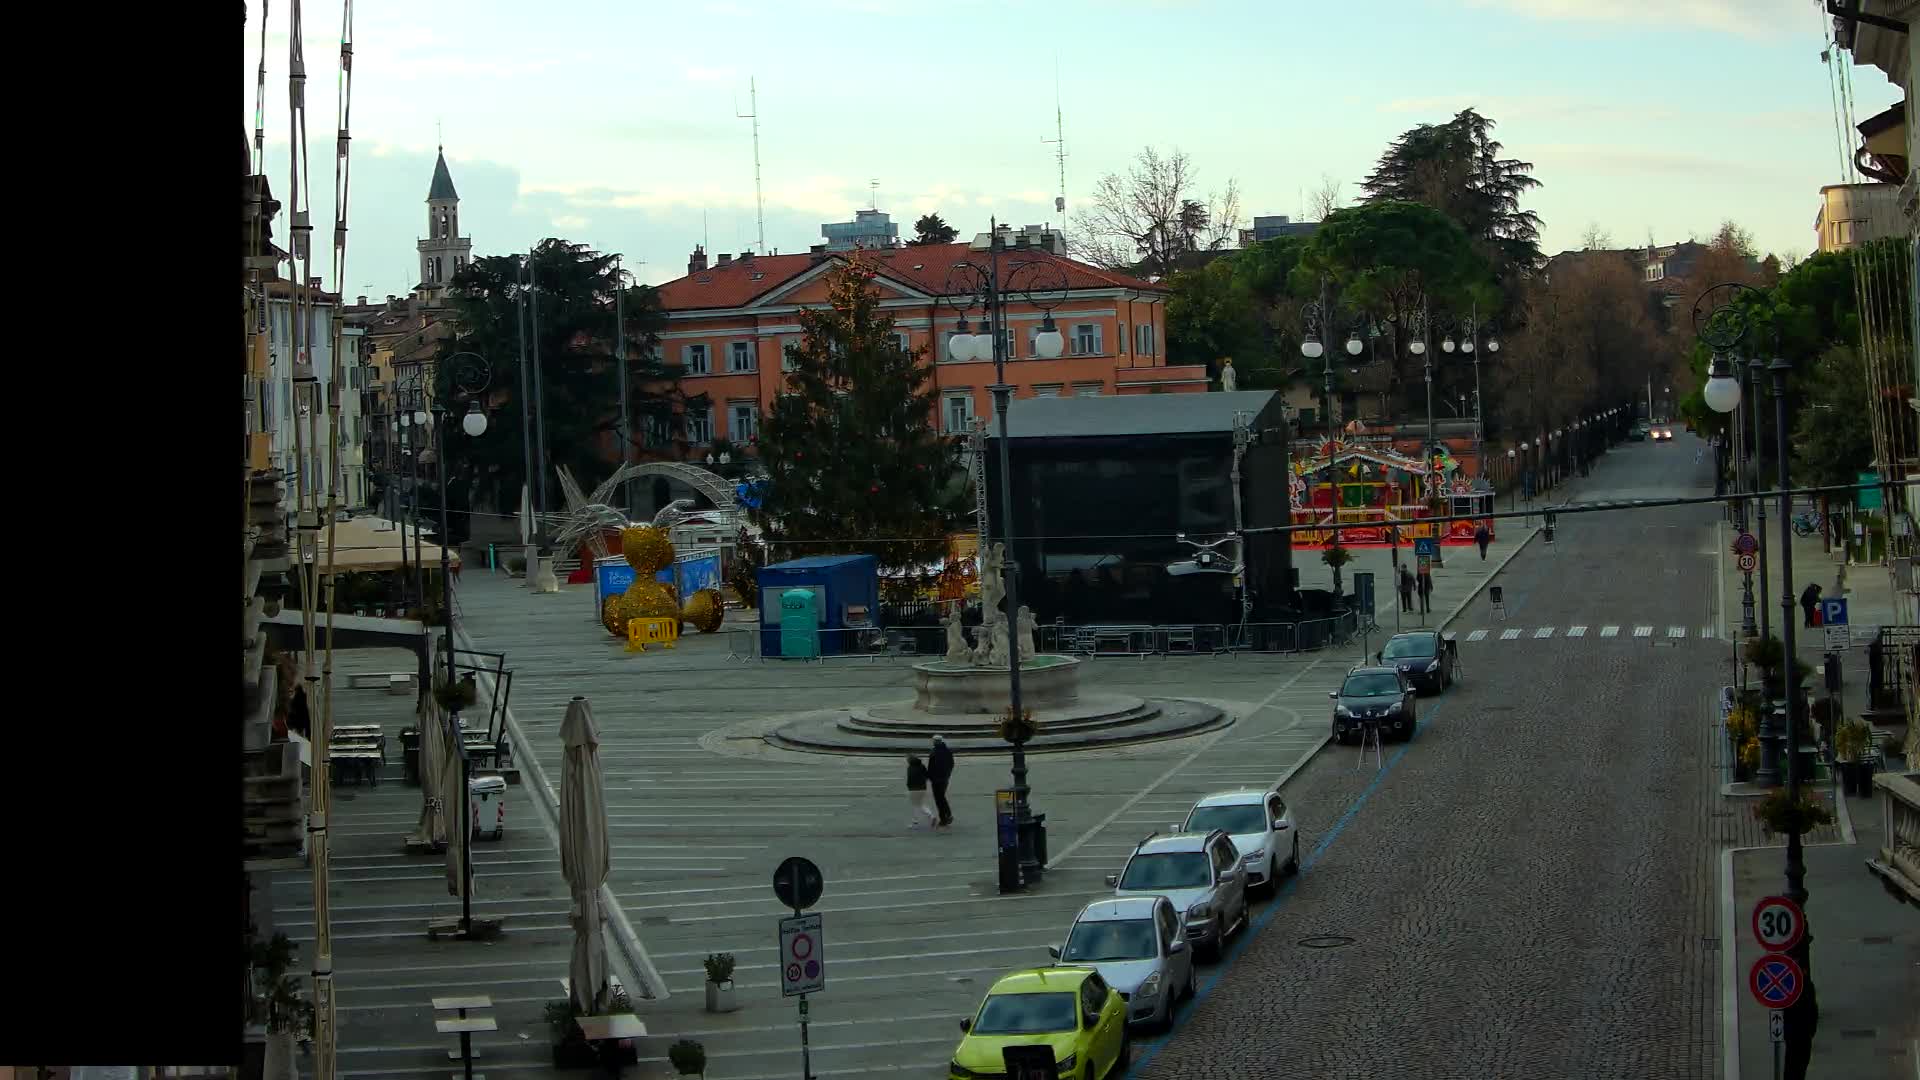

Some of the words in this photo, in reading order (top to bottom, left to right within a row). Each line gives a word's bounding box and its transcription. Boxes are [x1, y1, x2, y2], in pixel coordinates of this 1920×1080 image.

[1742, 557, 1753, 567] 20
[1827, 602, 1842, 622] P
[1762, 911, 1792, 938] 30
